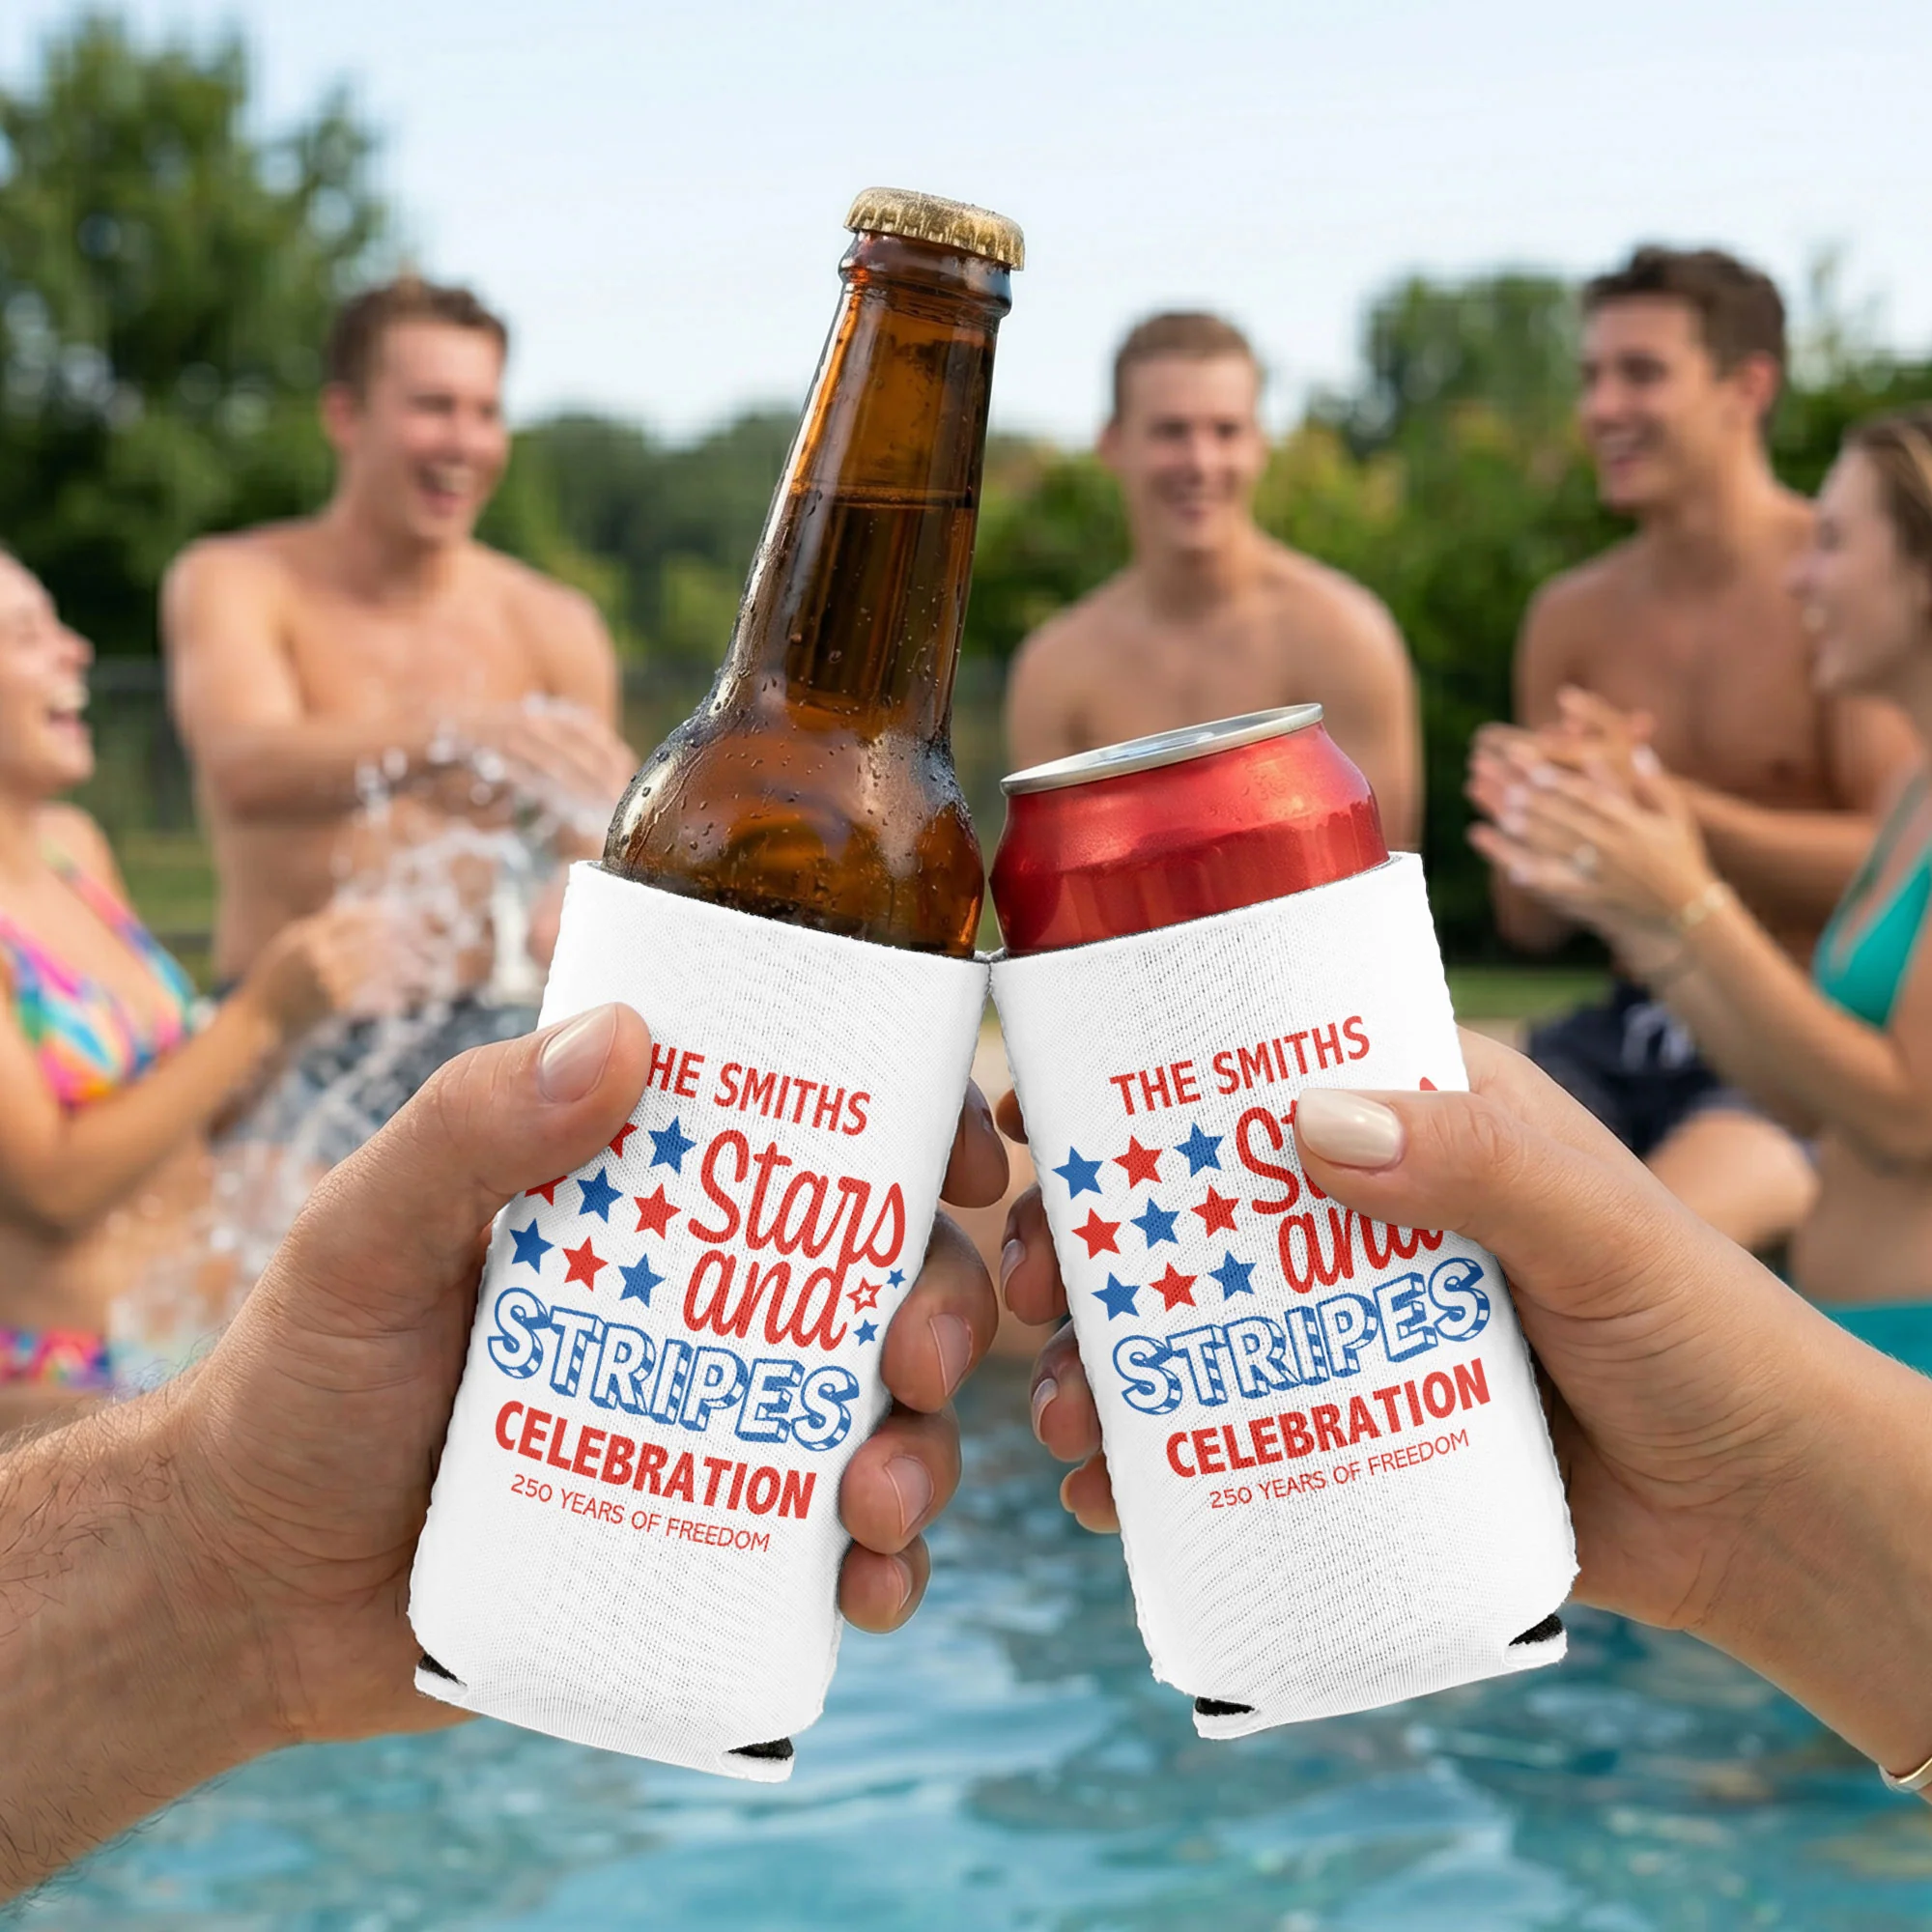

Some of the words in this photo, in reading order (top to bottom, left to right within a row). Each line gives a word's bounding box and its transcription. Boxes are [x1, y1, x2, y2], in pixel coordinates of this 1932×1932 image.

[647, 1042, 705, 1098] HE
[713, 1063, 870, 1136] SMITHS
[1110, 1060, 1202, 1116] THE
[1211, 1015, 1371, 1095] SMITHS
[687, 1129, 906, 1267] Stars
[682, 1250, 849, 1350] and
[1113, 1257, 1492, 1415] STRIPES
[487, 1287, 860, 1452] STRIPES
[1166, 1357, 1492, 1478] CELEBRATION
[495, 1401, 816, 1520] CELEBRATION
[510, 1473, 553, 1502] 250
[560, 1489, 625, 1524] YEARS
[631, 1510, 661, 1533] OF
[666, 1518, 770, 1552] FREEDOM
[1209, 1487, 1253, 1509] 250
[1259, 1470, 1326, 1500] YEARS
[1333, 1462, 1360, 1485] OF
[1368, 1429, 1469, 1476] FREEDOM
